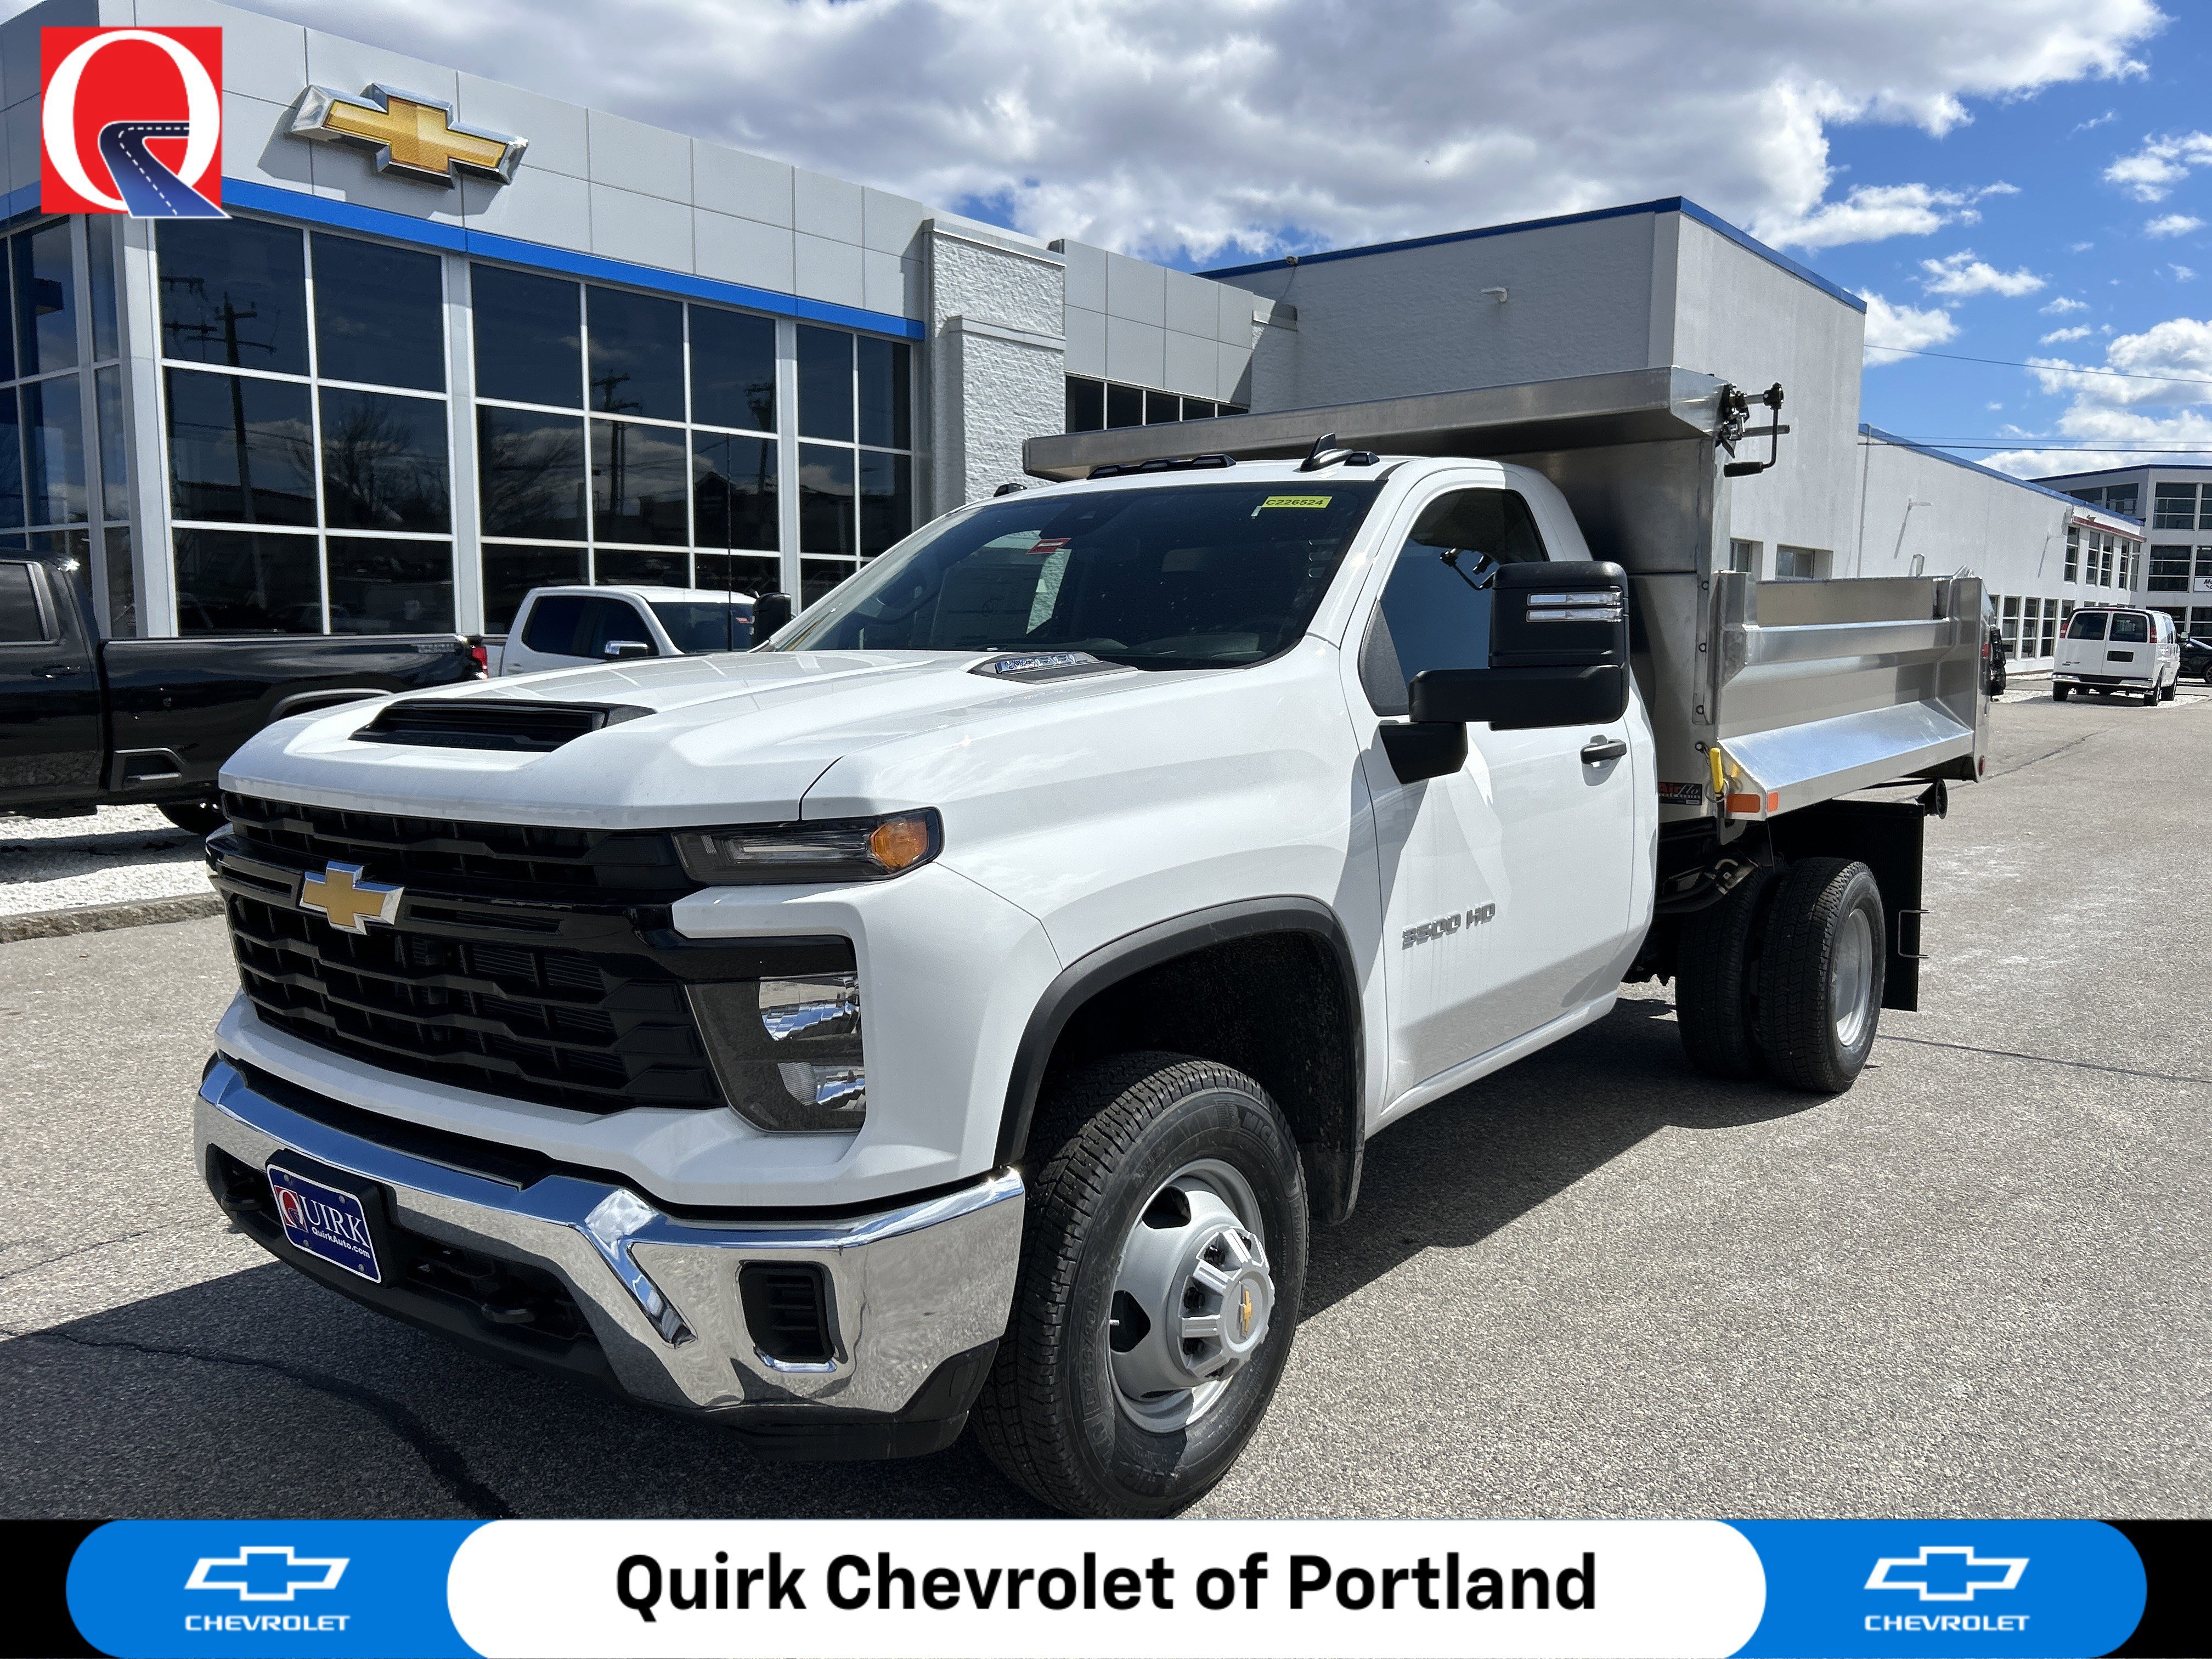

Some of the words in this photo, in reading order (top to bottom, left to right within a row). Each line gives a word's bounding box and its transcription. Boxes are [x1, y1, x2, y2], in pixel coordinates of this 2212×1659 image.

[1402, 913, 1462, 950] 3500
[1466, 902, 1496, 929] HD
[278, 1189, 371, 1248] QUIRK
[312, 1226, 371, 1259] QuirkAuto.com
